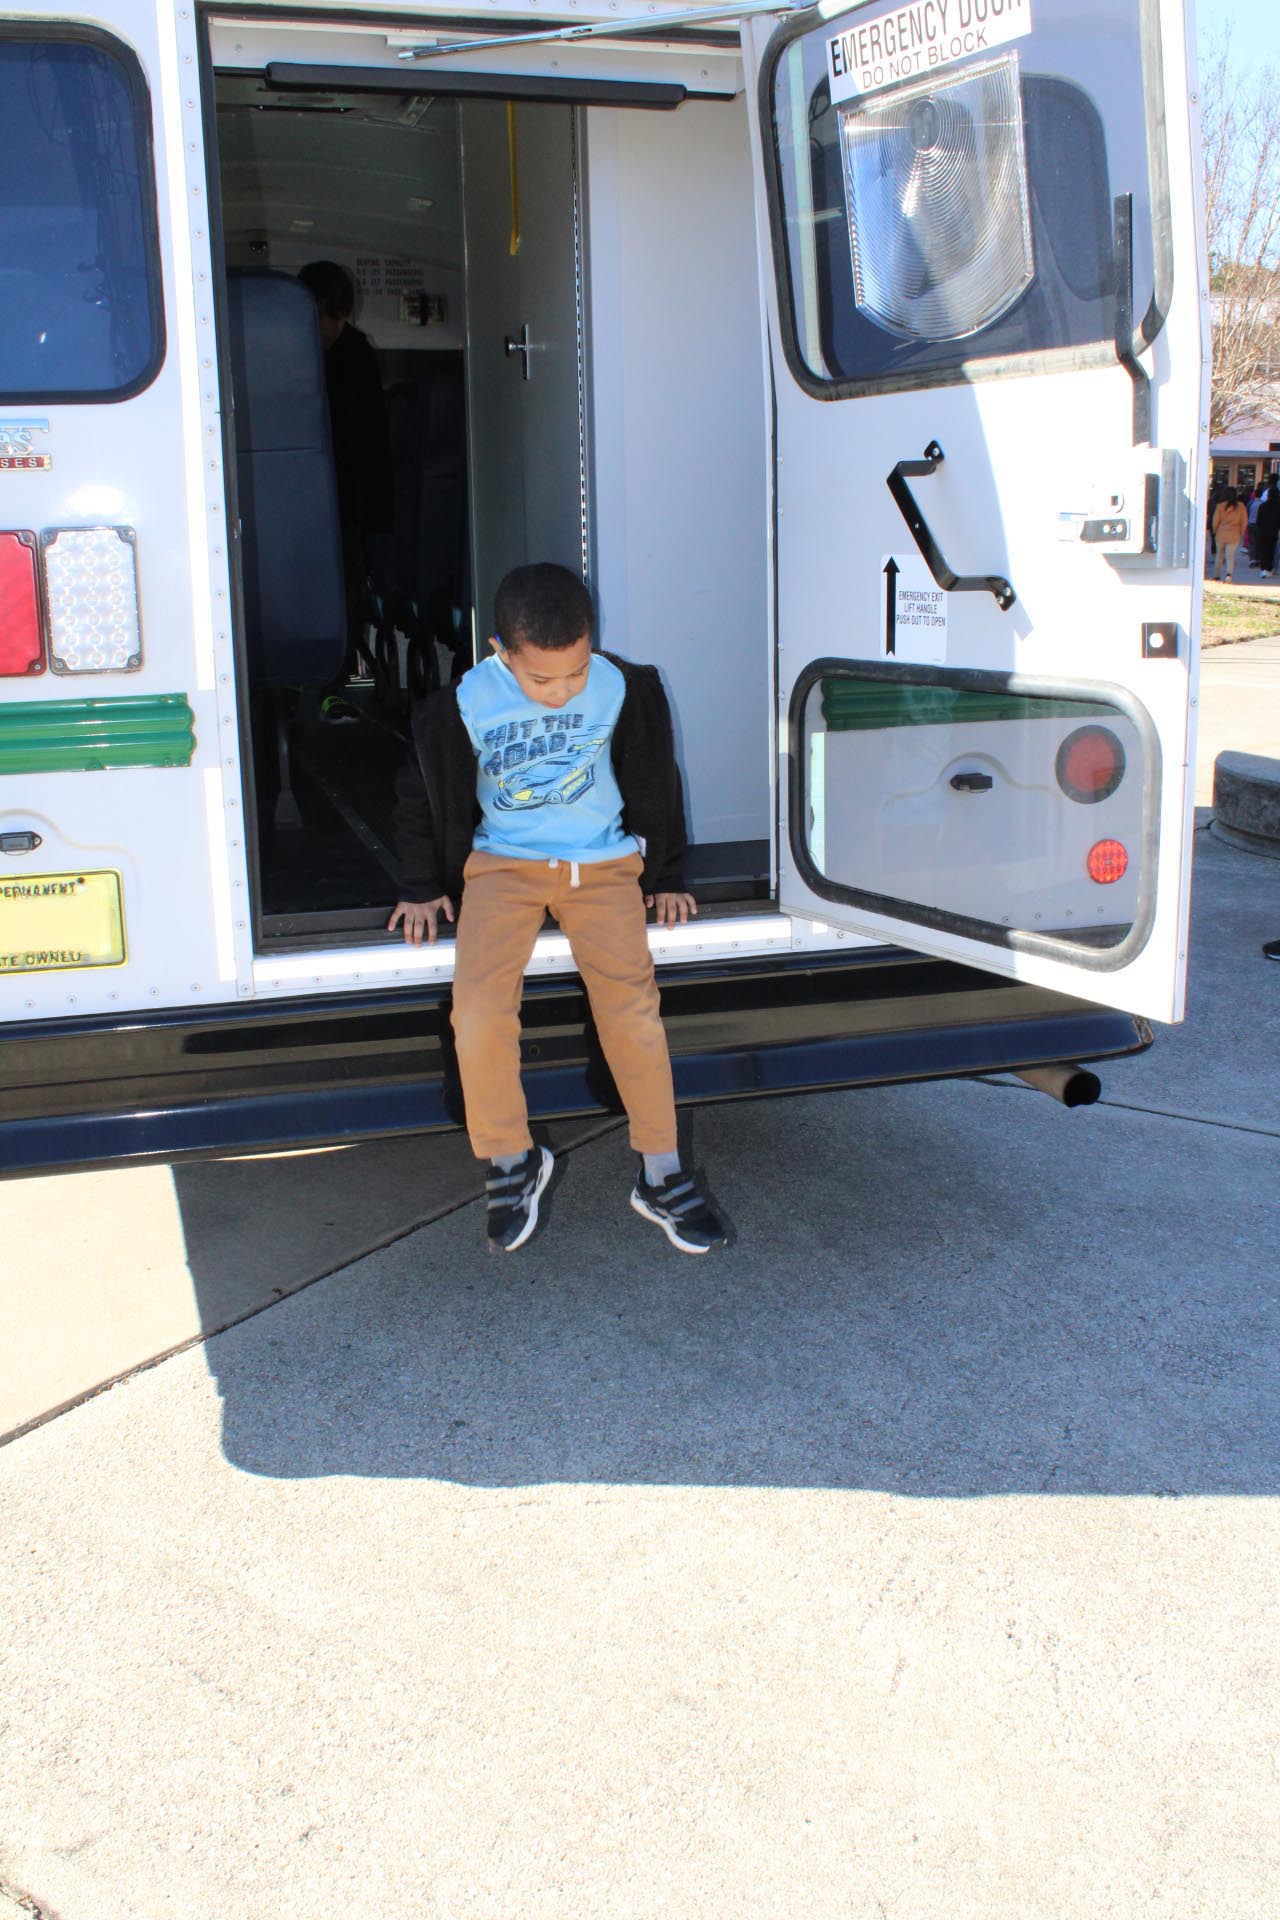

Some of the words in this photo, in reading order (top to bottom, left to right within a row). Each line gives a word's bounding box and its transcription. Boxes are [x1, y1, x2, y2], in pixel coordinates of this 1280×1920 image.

[830, 0, 948, 78] EMERGENCY
[958, 0, 1021, 29] DO
[863, 66, 884, 90] DO
[890, 52, 921, 77] NOT
[928, 27, 988, 66] BLOCK
[898, 590, 931, 602] EMERGENCY
[931, 592, 944, 602] EXIT
[904, 603, 915, 613] LIFT
[916, 604, 937, 614] HANDLE
[896, 615, 910, 625] PUSH
[911, 616, 922, 625] OUT
[923, 616, 930, 626] TO
[931, 617, 946, 627] OPEN
[483, 718, 537, 749] HIT
[542, 713, 584, 733] THE
[483, 732, 567, 777] ROAD
